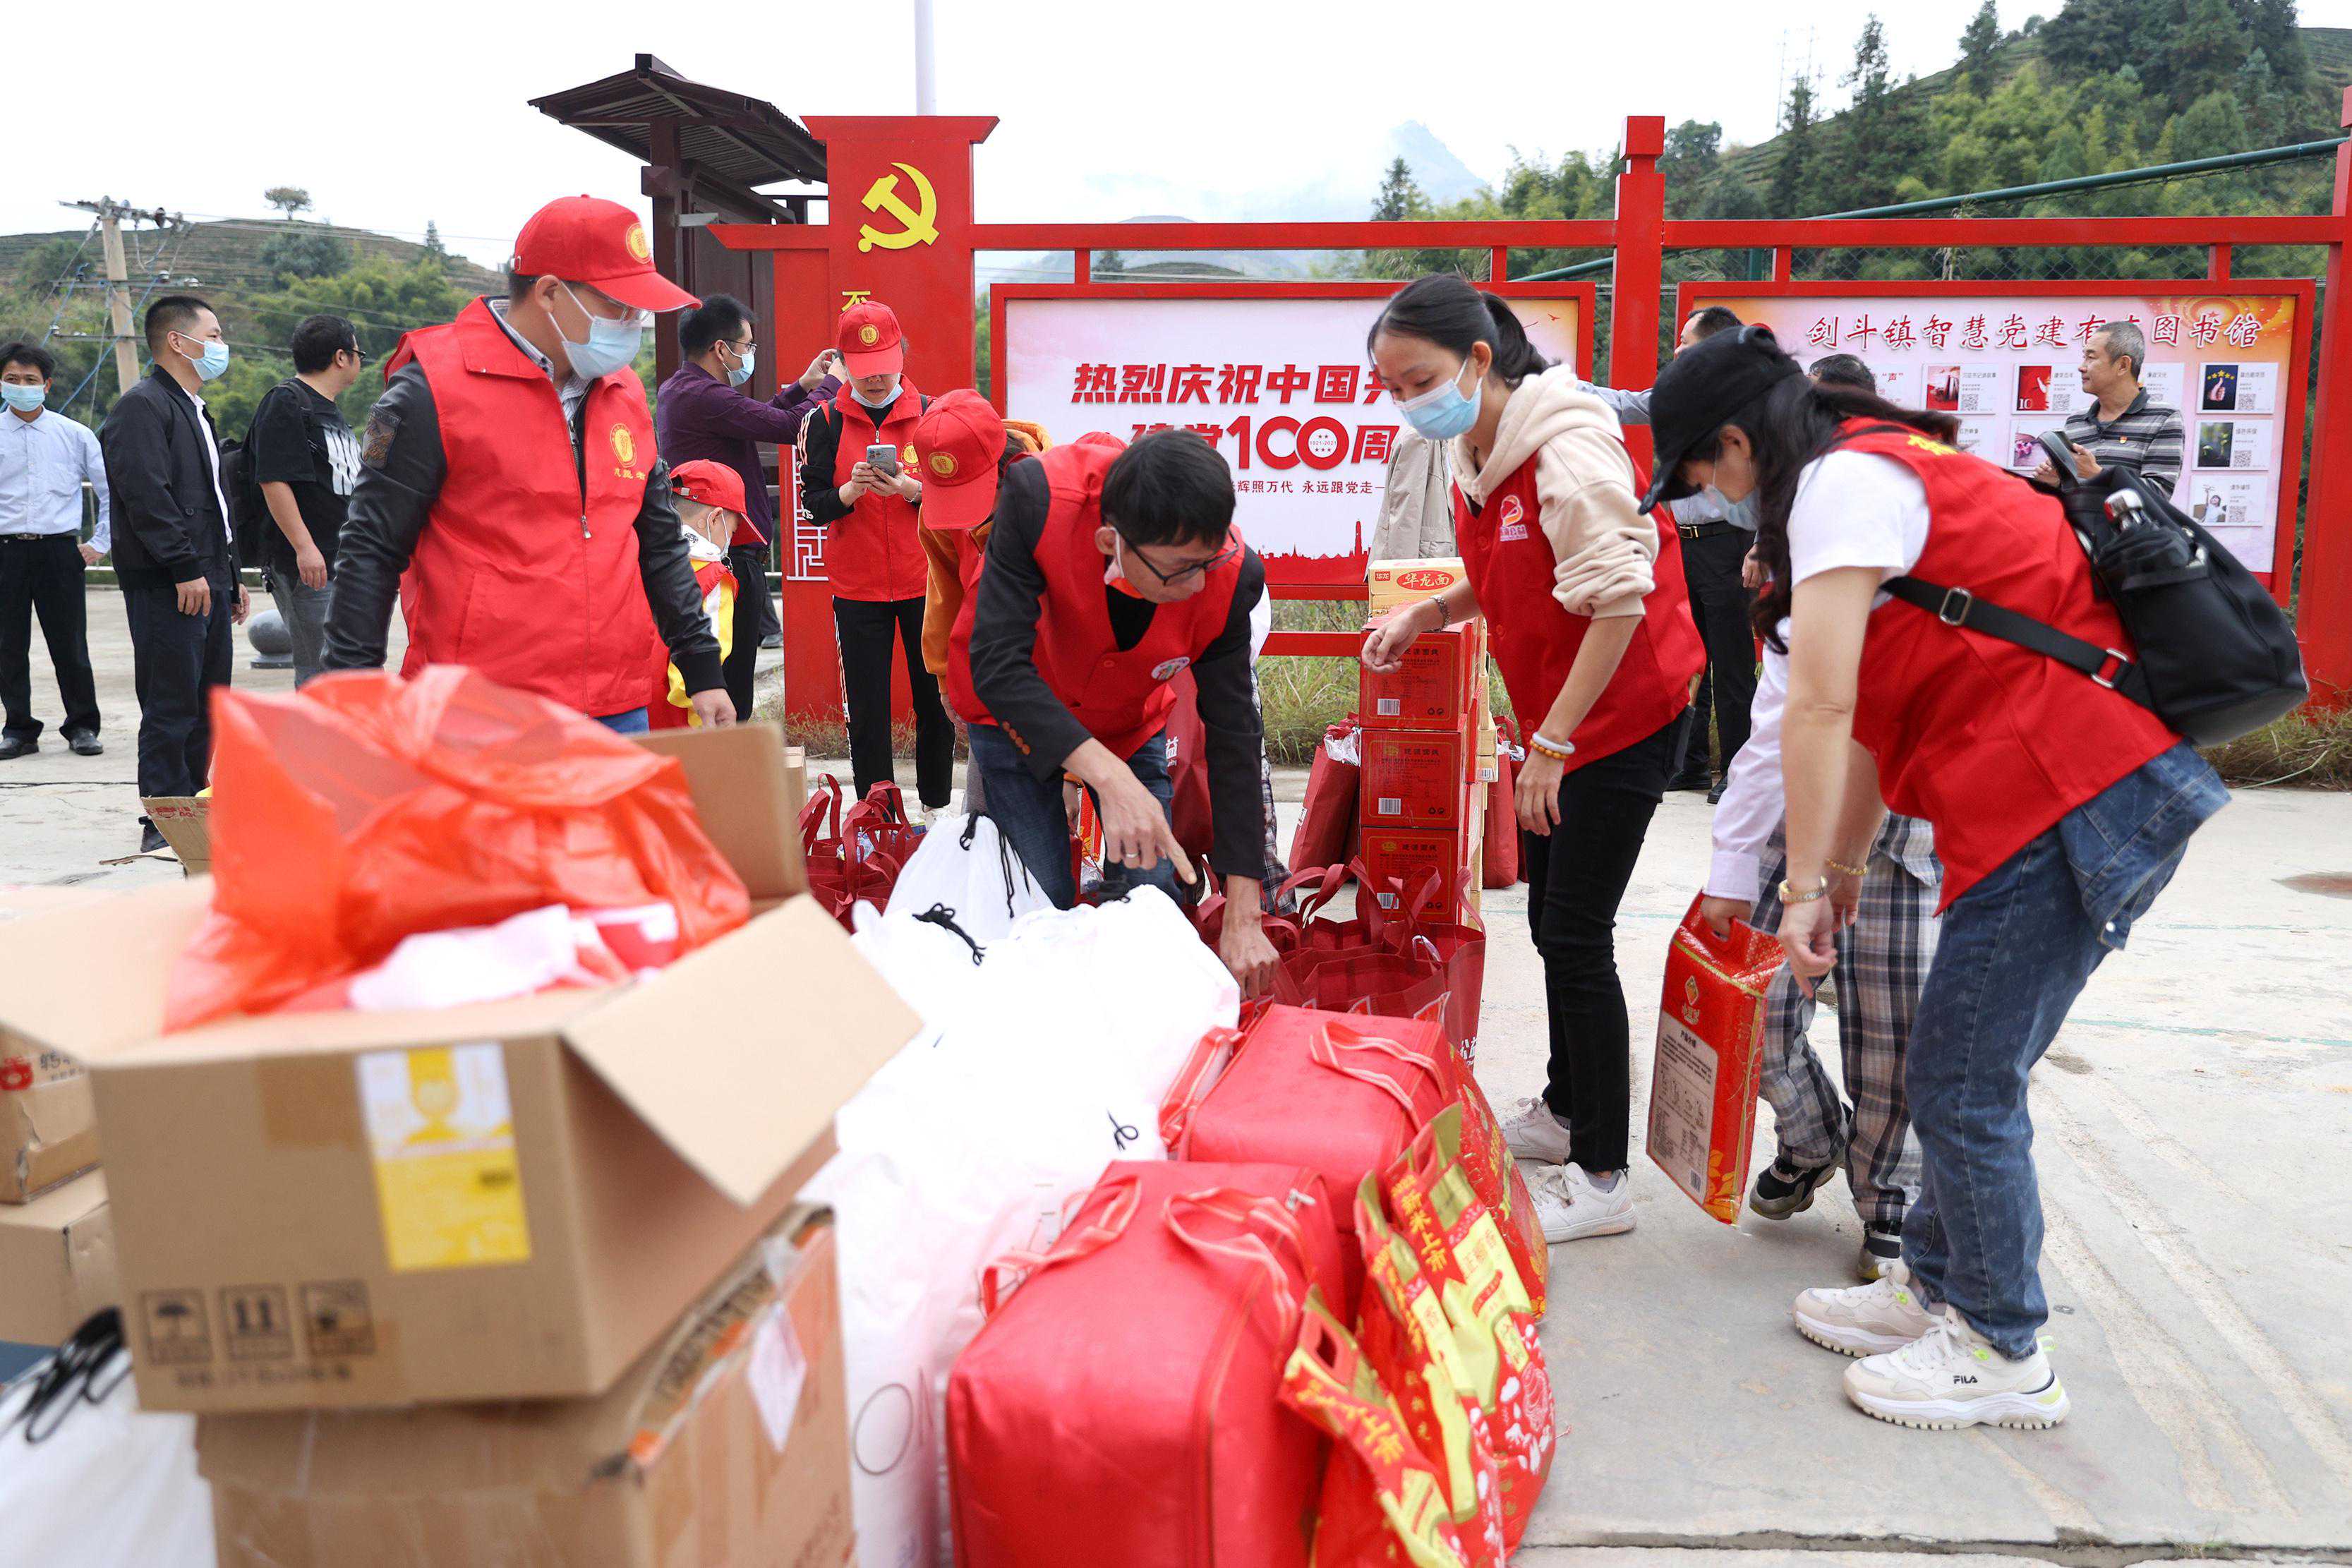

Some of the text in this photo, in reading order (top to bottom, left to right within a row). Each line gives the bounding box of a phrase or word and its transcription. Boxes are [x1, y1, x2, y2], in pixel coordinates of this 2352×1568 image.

[1807, 313, 2261, 350] 剑斗镇智慧党建有图书馆
[1231, 481, 1293, 494] 辉照万代
[1375, 572, 1390, 580] 华龙
[1403, 573, 1451, 589] 华龙面
[1953, 1375, 1978, 1385] FILA
